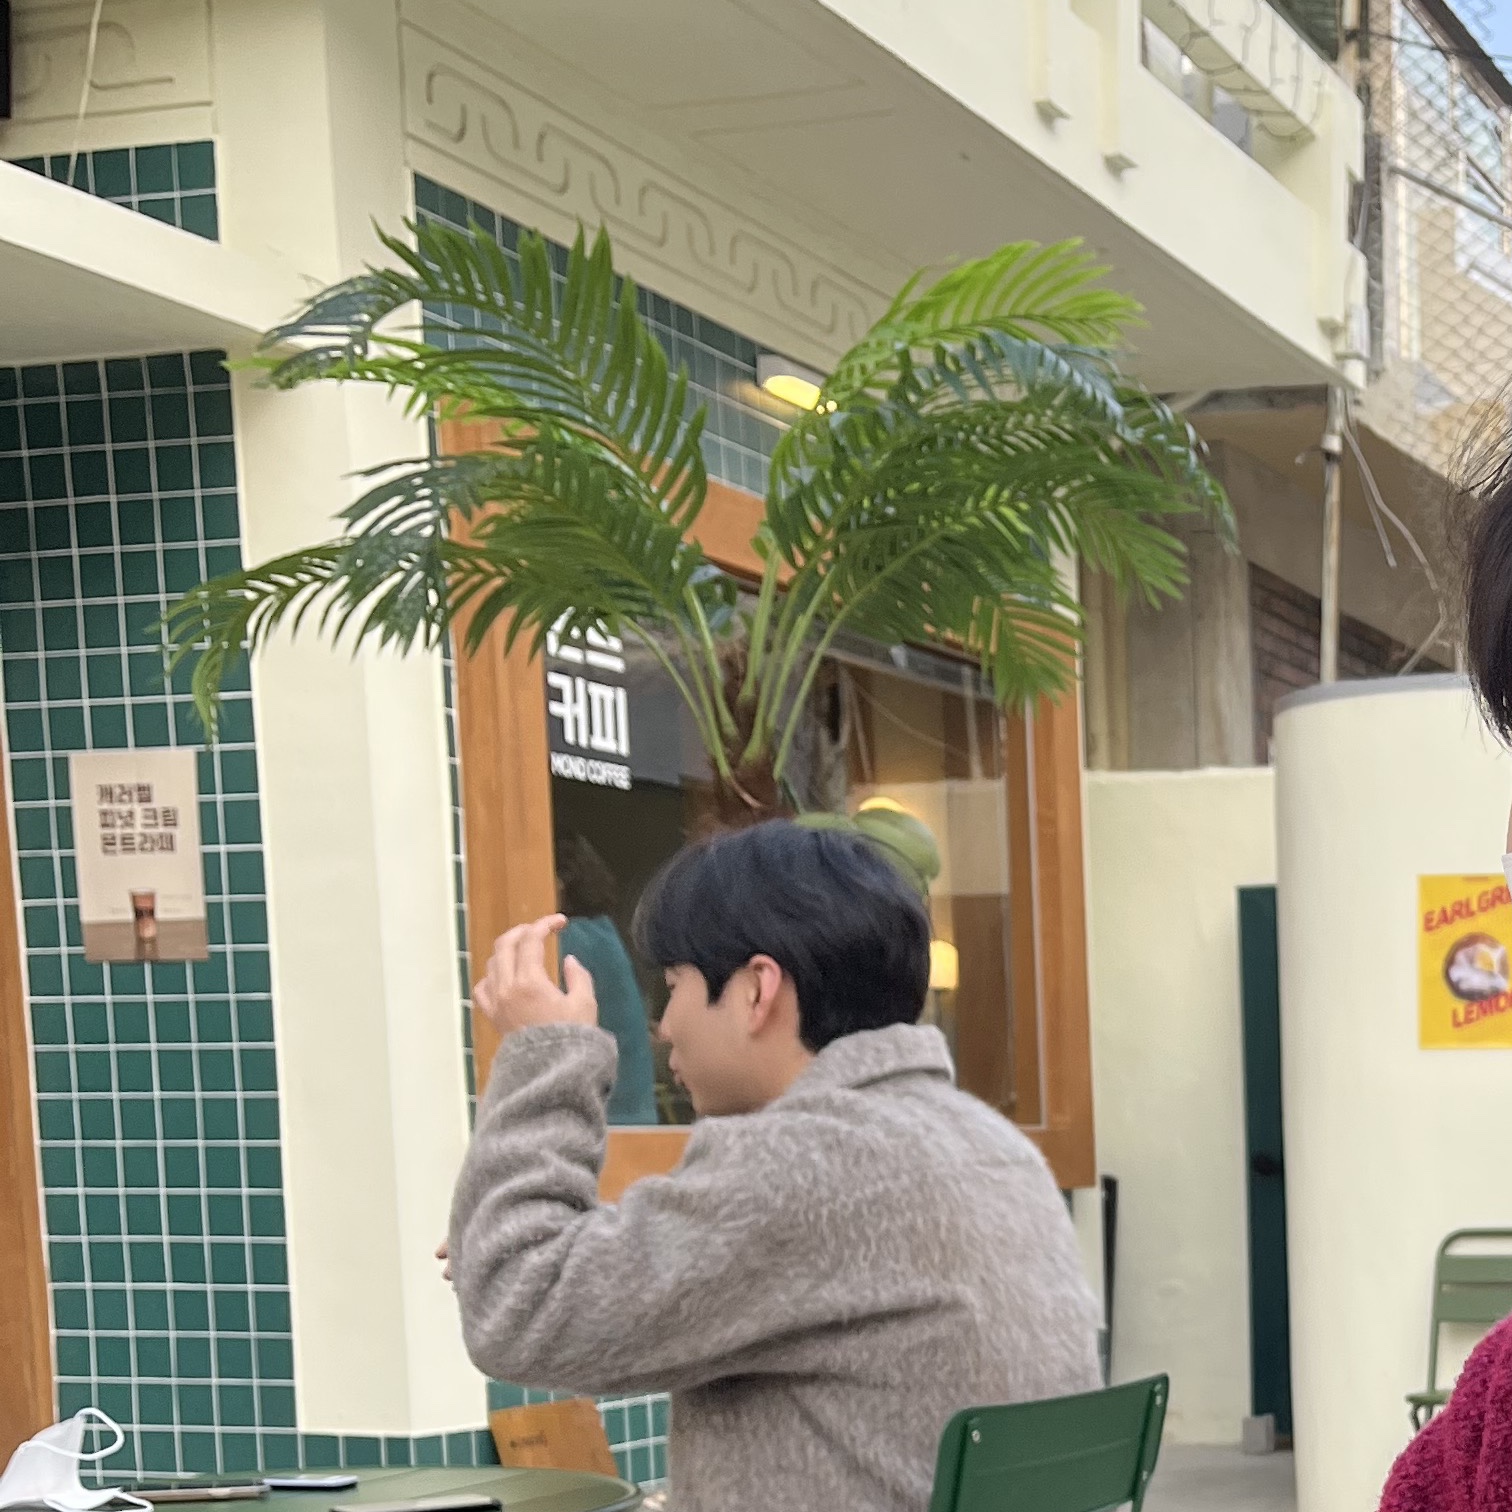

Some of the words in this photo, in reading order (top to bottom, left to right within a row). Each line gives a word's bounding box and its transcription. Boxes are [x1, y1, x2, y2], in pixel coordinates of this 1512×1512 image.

[547, 671, 630, 757] 커피
[587, 758, 632, 790] COFFEE
[1424, 897, 1475, 932] EARL
